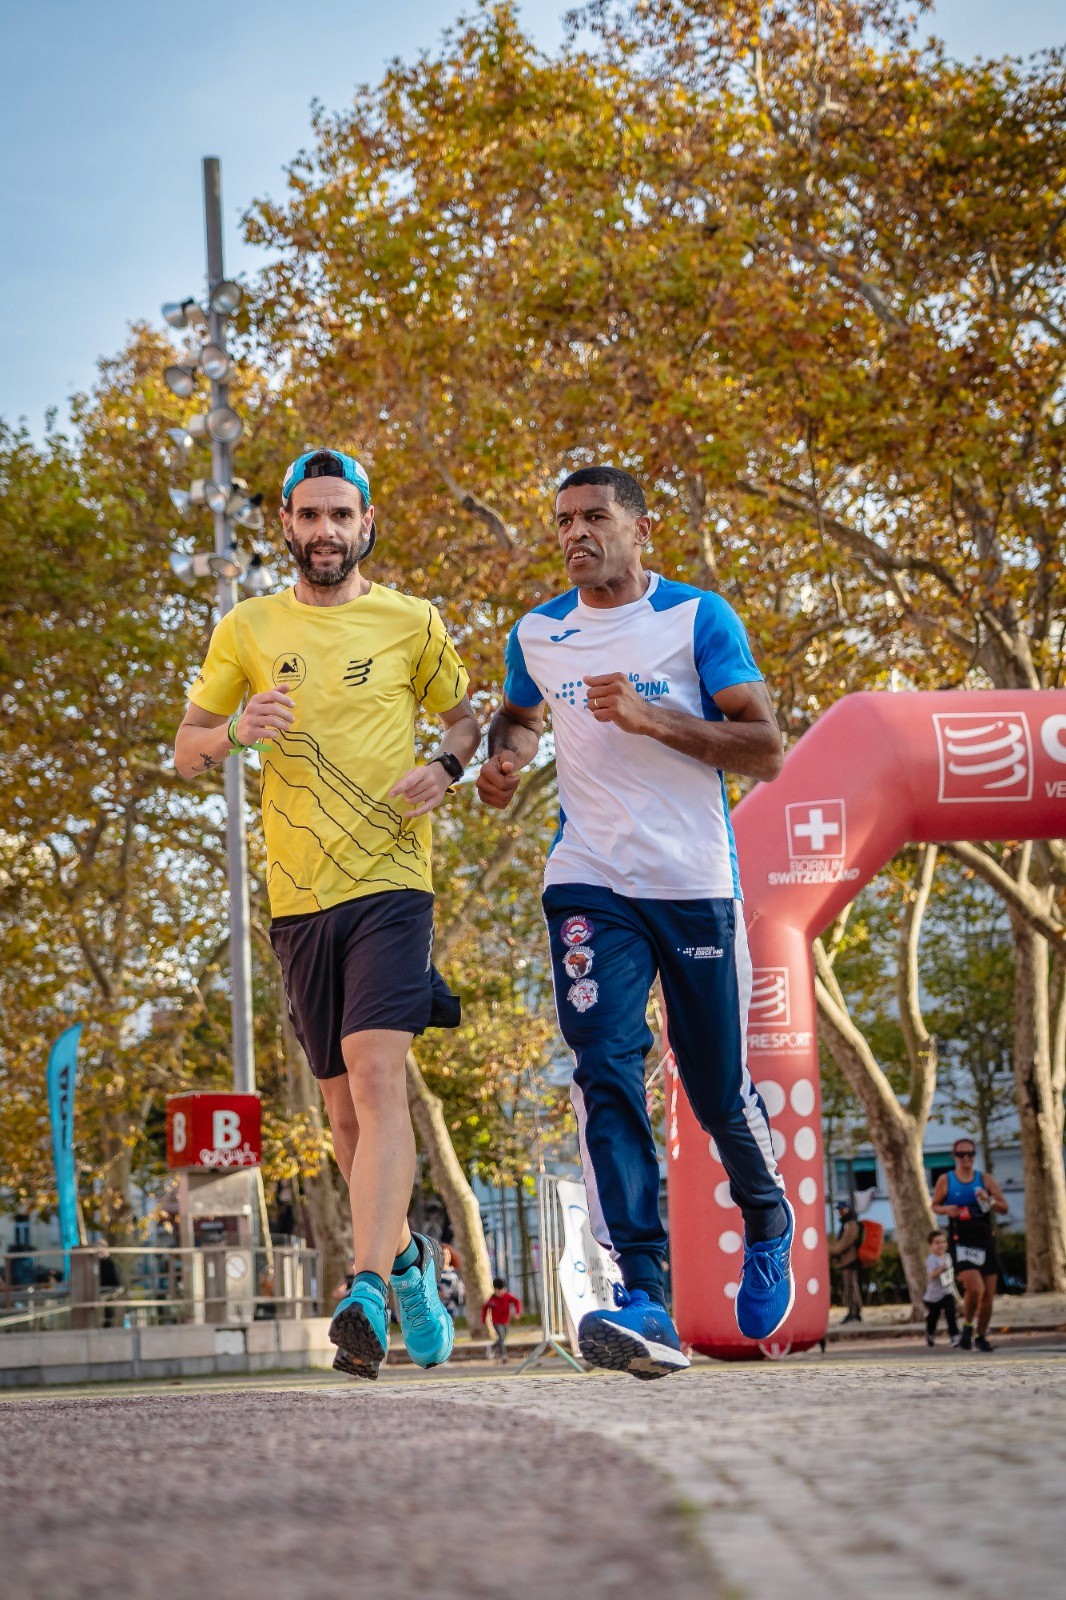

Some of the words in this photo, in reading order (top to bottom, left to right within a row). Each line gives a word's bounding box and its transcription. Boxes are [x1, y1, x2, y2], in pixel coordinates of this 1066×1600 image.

[768, 867, 861, 885] SWITZERLAND
[789, 859, 825, 872] BORN
[825, 858, 845, 873] IN
[172, 1111, 187, 1153] B
[212, 1109, 242, 1150] B
